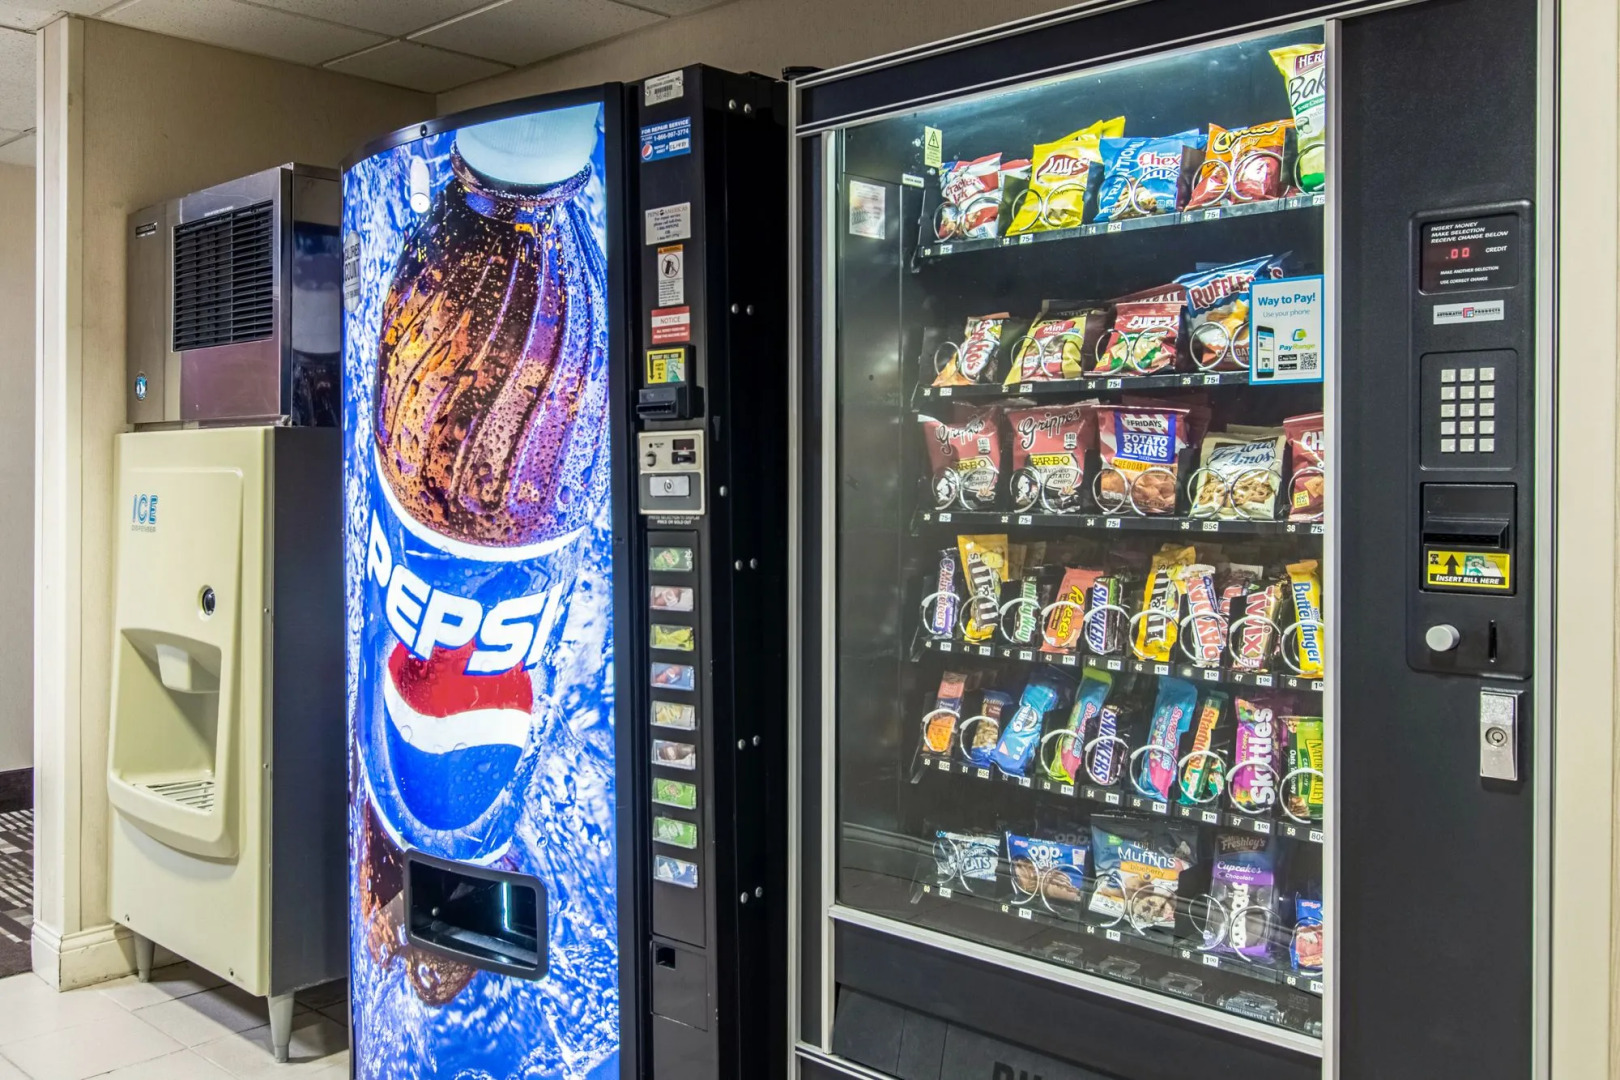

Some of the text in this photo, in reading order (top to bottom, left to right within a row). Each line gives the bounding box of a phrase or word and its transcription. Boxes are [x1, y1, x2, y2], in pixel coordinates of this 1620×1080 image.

[1139, 151, 1182, 166] Chex
[1450, 227, 1486, 236] SELECTION
[1484, 230, 1509, 238] BELOW
[1485, 245, 1508, 254] CREDIT
[1190, 274, 1256, 310] RUFFLES
[1257, 292, 1316, 307] Way to Pay!
[1290, 308, 1311, 318] phone
[660, 315, 681, 324] NOTICE
[1044, 324, 1065, 332] Mini
[1123, 434, 1168, 446] POTATO
[1123, 442, 1168, 458] SKINS
[956, 460, 987, 471] AR-B-Q
[1113, 459, 1142, 471] CHEDDAR
[132, 493, 159, 525] ICE
[1435, 574, 1462, 582] INSERT
[366, 509, 565, 672] PEPSI
[936, 570, 953, 628] Museteers
[1016, 582, 1037, 642] Miky Way
[1234, 674, 1243, 682] 47
[1152, 723, 1166, 763] CHEY
[1190, 708, 1216, 771] Starbust
[1249, 707, 1276, 806] Skittles
[1289, 749, 1298, 766] Oats
[1309, 742, 1323, 774] NATUR
[1133, 798, 1141, 806] 55
[1182, 808, 1190, 816] 56
[1233, 818, 1242, 826] 57
[1287, 828, 1296, 836] 58
[1222, 837, 1266, 851] Freshley's
[1118, 846, 1176, 868] Muffins
[1216, 860, 1262, 875] Cupcakes
[1225, 872, 1254, 882] Chocolate
[1182, 950, 1191, 959] 66
[1287, 976, 1296, 986] 68
